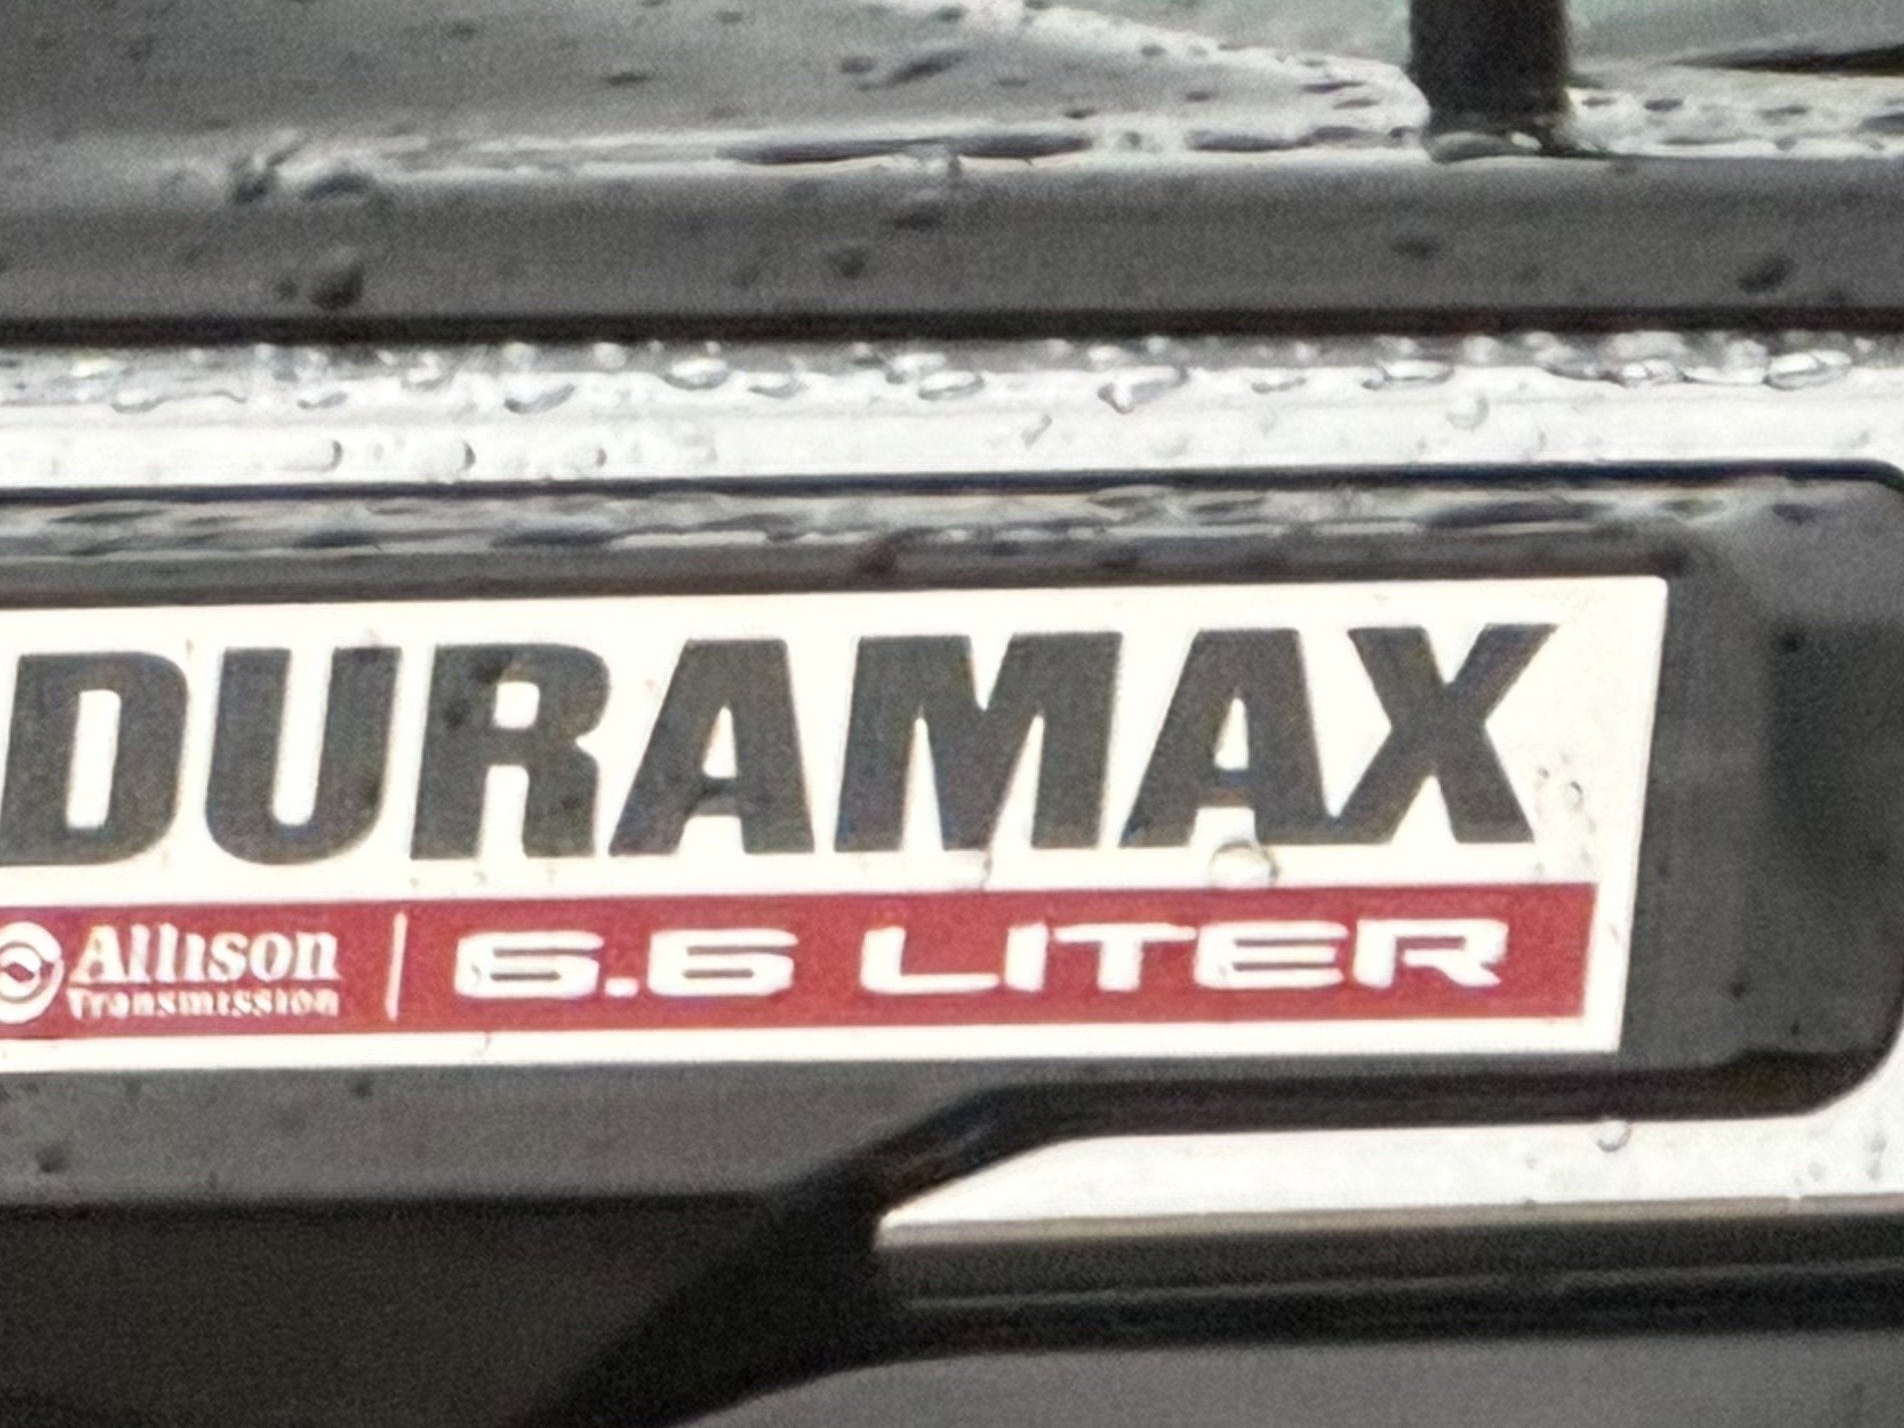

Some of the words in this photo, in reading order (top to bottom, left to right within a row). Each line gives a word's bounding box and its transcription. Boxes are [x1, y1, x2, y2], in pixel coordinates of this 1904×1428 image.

[69, 923, 342, 983] Allison
[454, 928, 798, 1000] 6.6
[860, 918, 1509, 994] LITER
[67, 986, 340, 1020] Transmission
